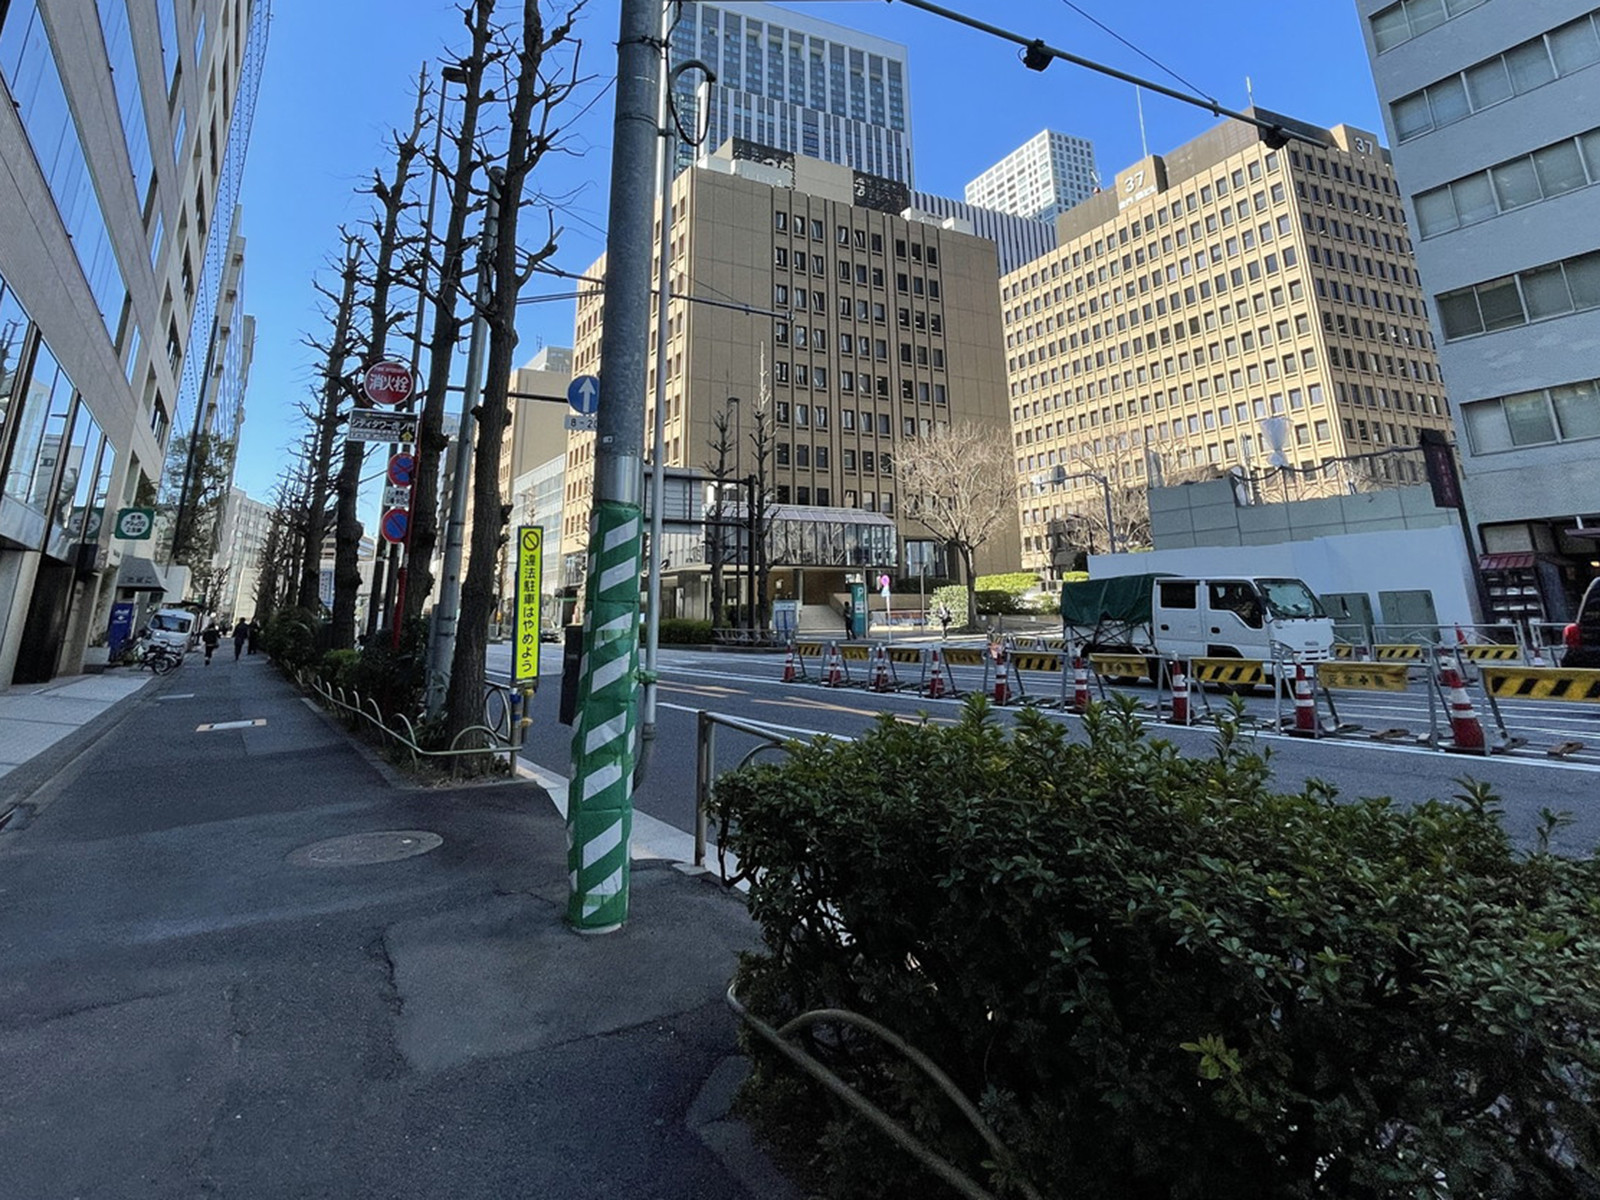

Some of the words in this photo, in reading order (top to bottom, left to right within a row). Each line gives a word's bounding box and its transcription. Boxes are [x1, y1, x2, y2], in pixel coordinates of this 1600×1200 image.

[1354, 136, 1374, 155] 37
[1124, 170, 1145, 193] 37
[368, 373, 410, 393] 消火栓
[521, 554, 536, 673] 違法駐車はやめよう
